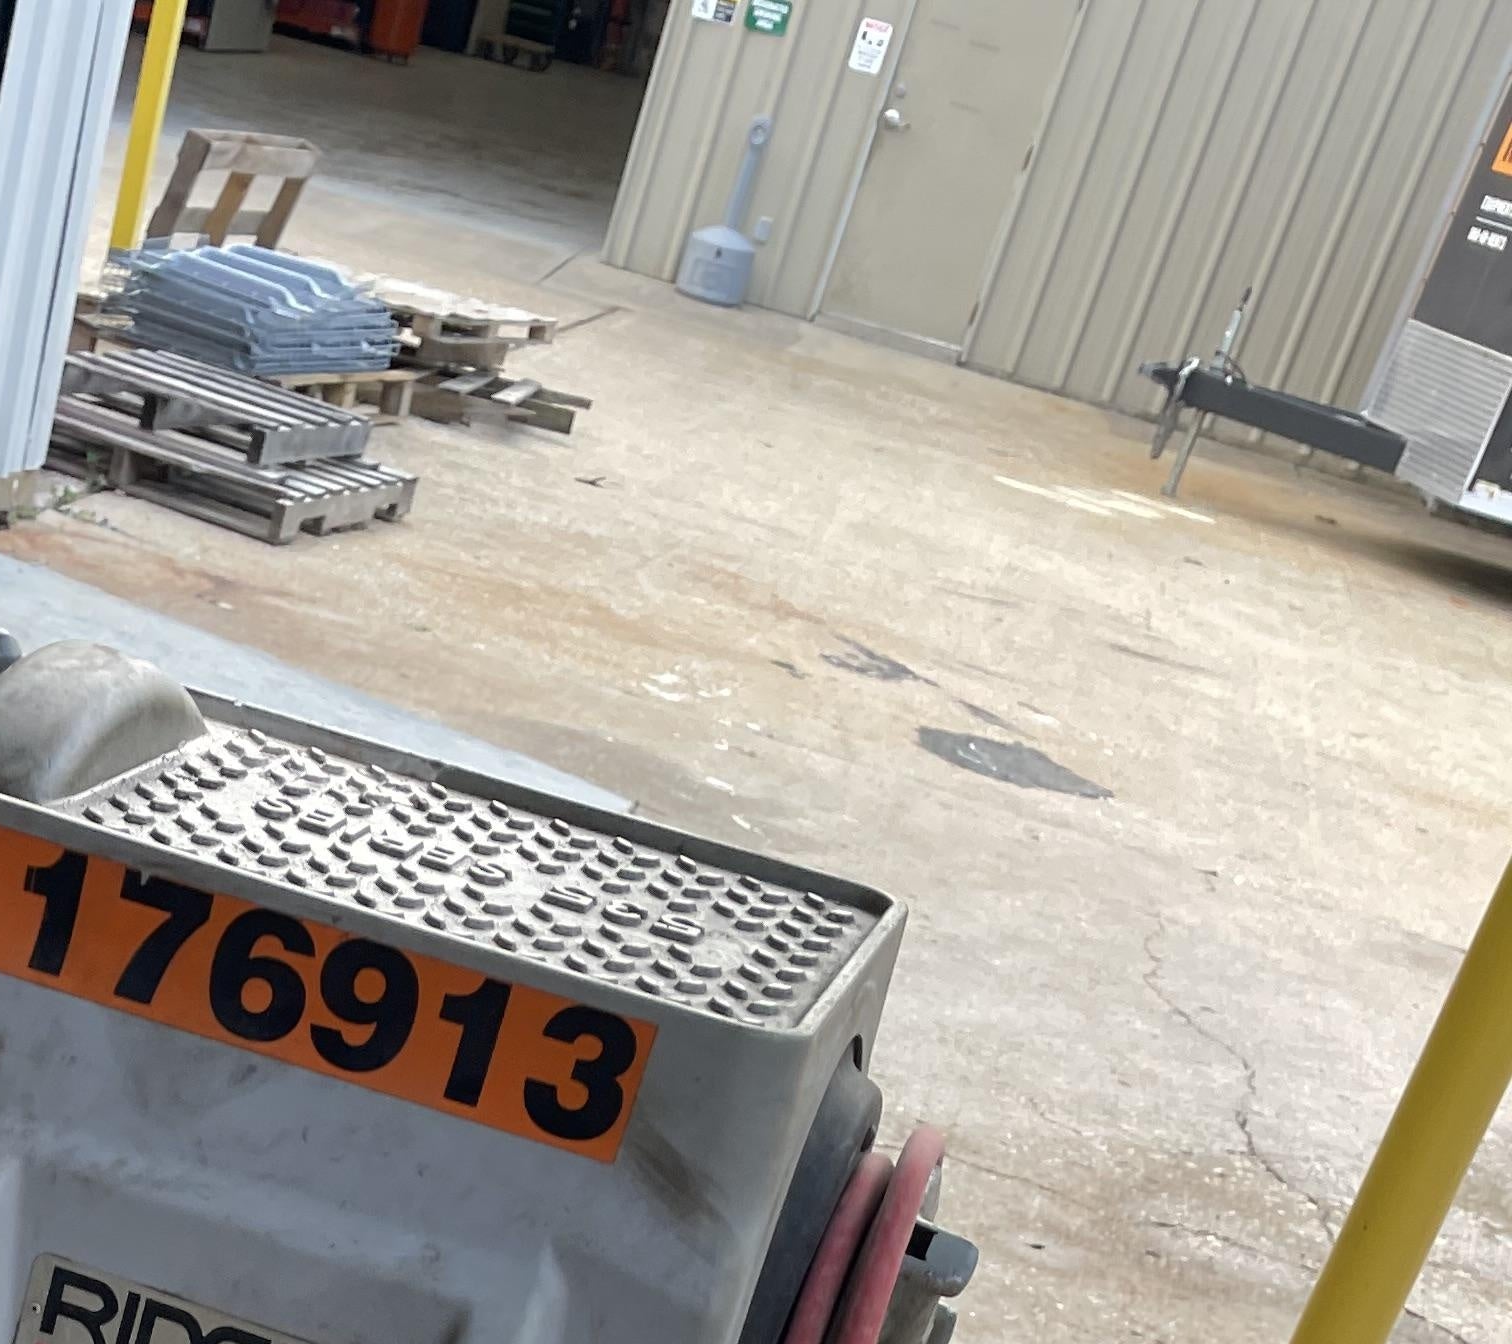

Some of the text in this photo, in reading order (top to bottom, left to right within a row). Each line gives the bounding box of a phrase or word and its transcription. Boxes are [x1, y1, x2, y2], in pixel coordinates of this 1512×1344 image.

[253, 795, 706, 944] 535 SERIES
[23, 850, 637, 1141] 176913
